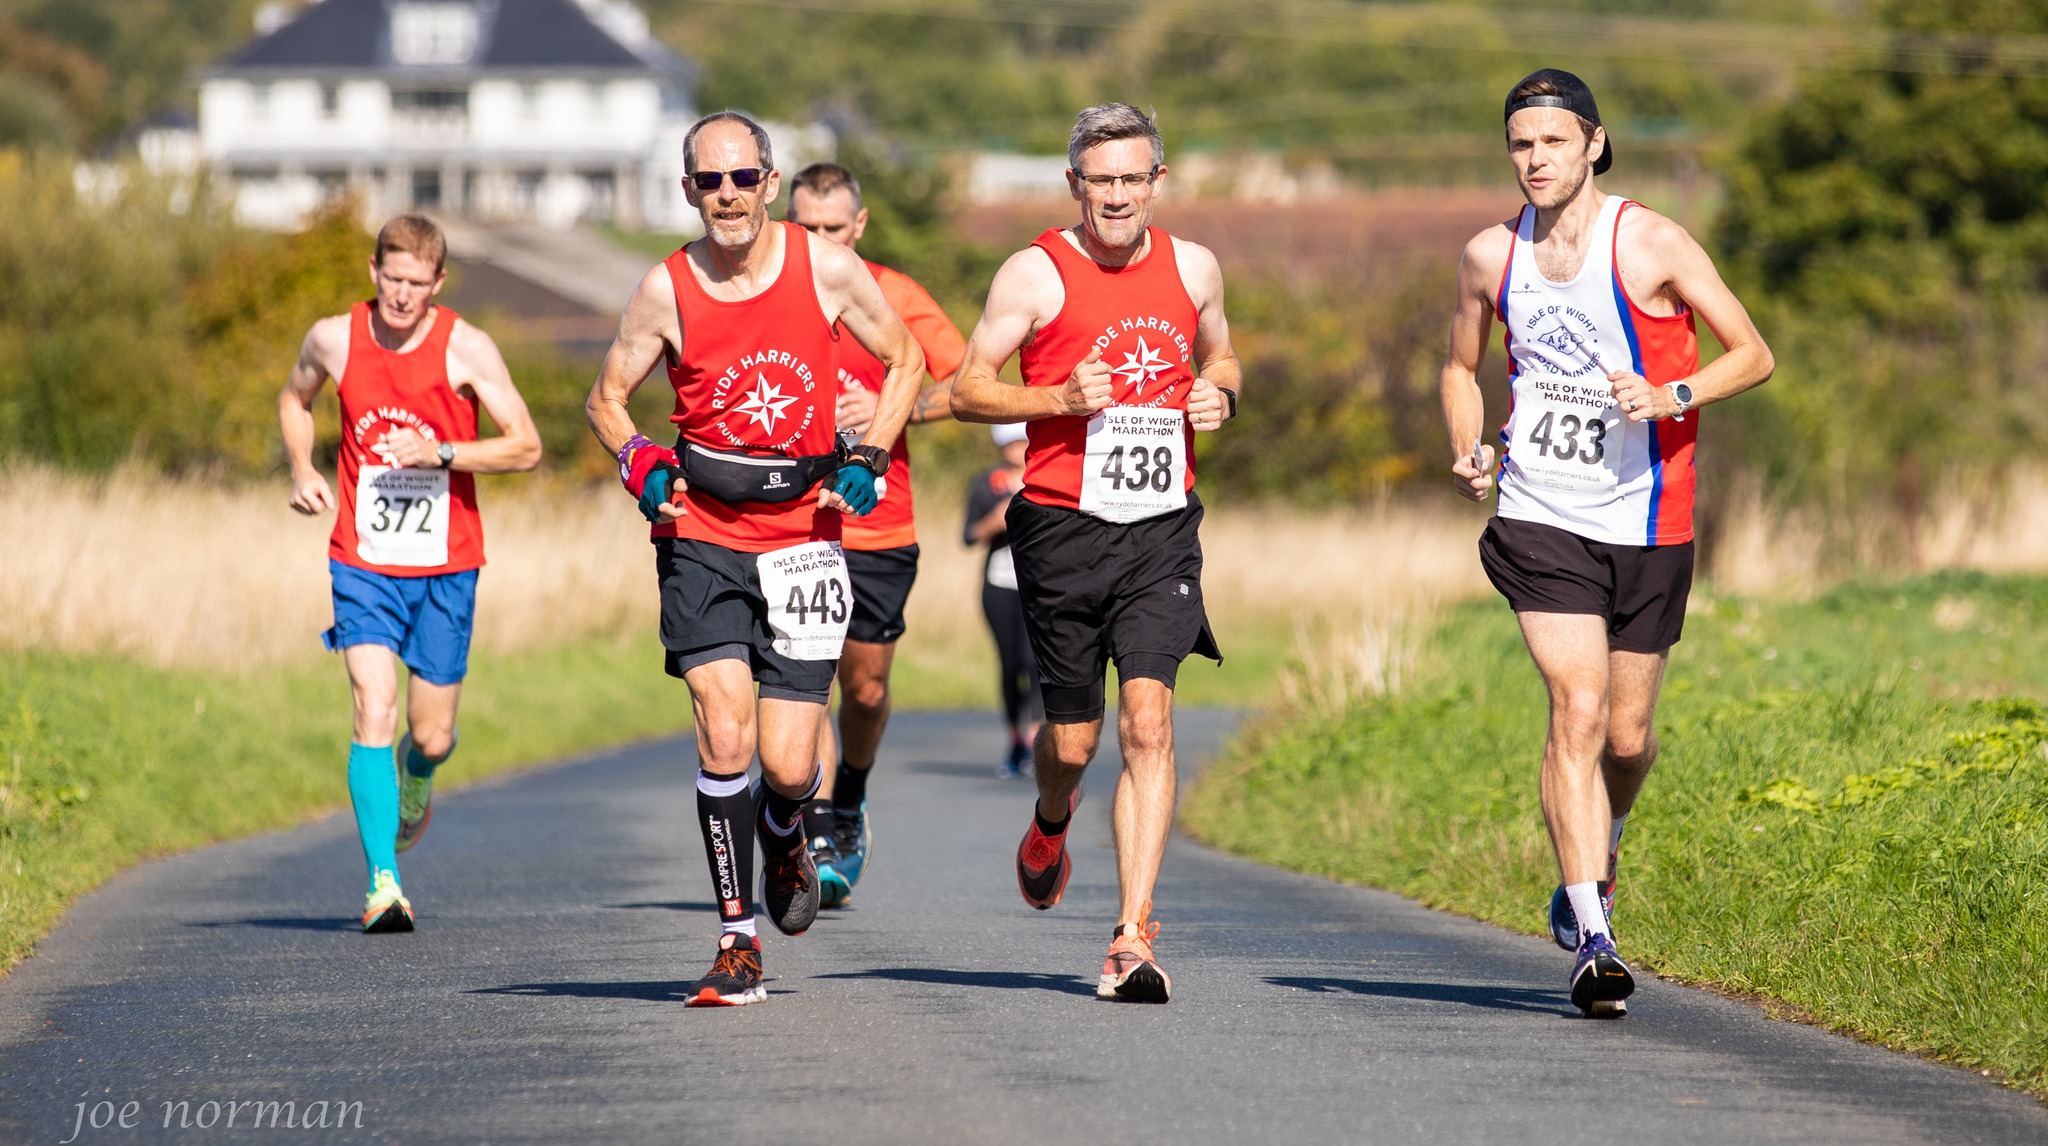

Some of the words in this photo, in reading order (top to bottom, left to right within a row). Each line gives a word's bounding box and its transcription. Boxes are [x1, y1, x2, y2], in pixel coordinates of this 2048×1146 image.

[1527, 308, 1546, 330] ISLE
[1547, 306, 1562, 315] OF
[1566, 306, 1597, 333] WIGHT
[1120, 316, 1189, 363] HARRIERS
[712, 365, 740, 409] RYDE
[740, 350, 815, 393] HARRIERS
[1535, 382, 1559, 392] ISLE
[1562, 385, 1578, 394] OF
[1582, 387, 1613, 399] WIGH
[1544, 392, 1613, 410] MARATHON
[801, 405, 814, 430] 1886
[1104, 416, 1128, 424] ISLE
[1130, 416, 1144, 424] OF
[1147, 417, 1182, 427] WIGHT
[1112, 426, 1174, 436] MARATHON
[1529, 411, 1606, 465] 433
[1100, 446, 1172, 493] 438
[371, 497, 432, 533] 372
[773, 556, 797, 569] ISLE
[800, 551, 815, 562] OF
[784, 559, 839, 577] MARATHON
[785, 577, 847, 625] 443
